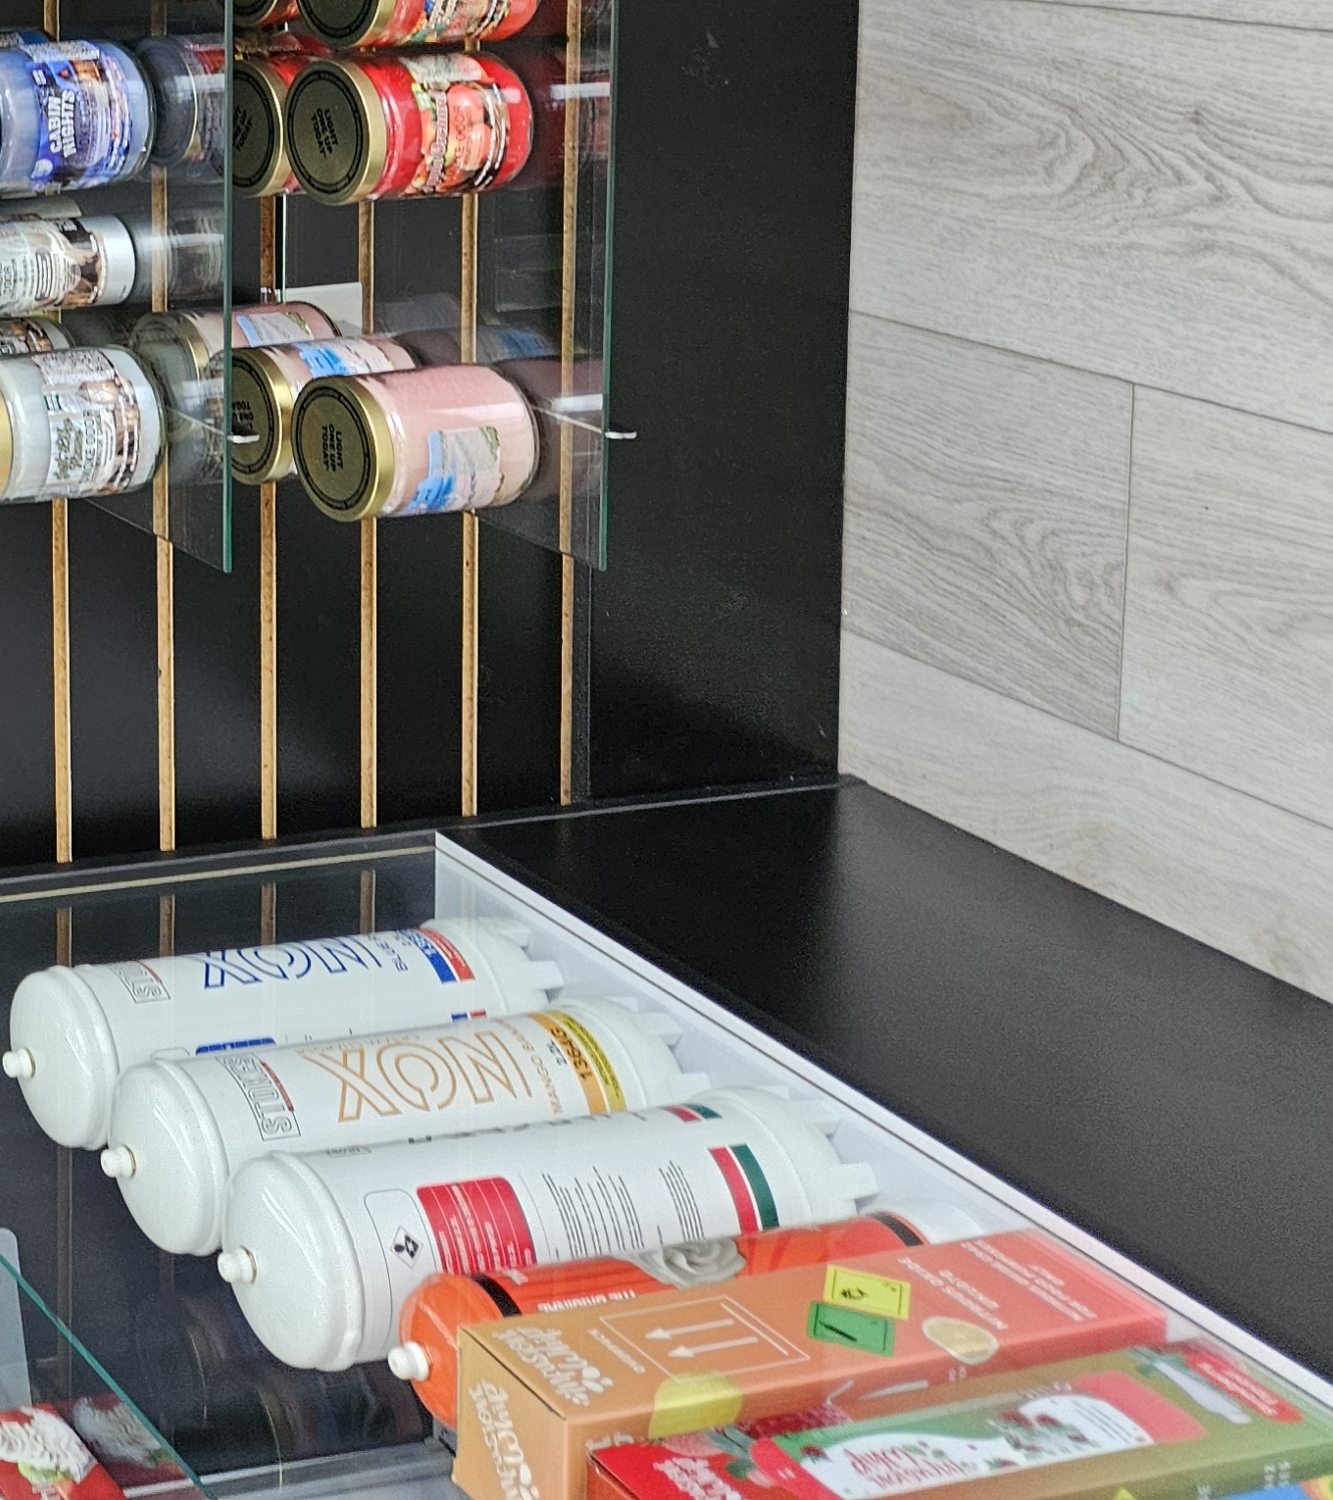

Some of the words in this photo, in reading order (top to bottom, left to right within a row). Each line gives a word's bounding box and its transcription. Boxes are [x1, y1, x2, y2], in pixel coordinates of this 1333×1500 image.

[48, 96, 63, 153] CABIN
[60, 89, 76, 157] NIGHTS
[228, 1056, 291, 1133] STOKES
[533, 1056, 563, 1114] MANGO
